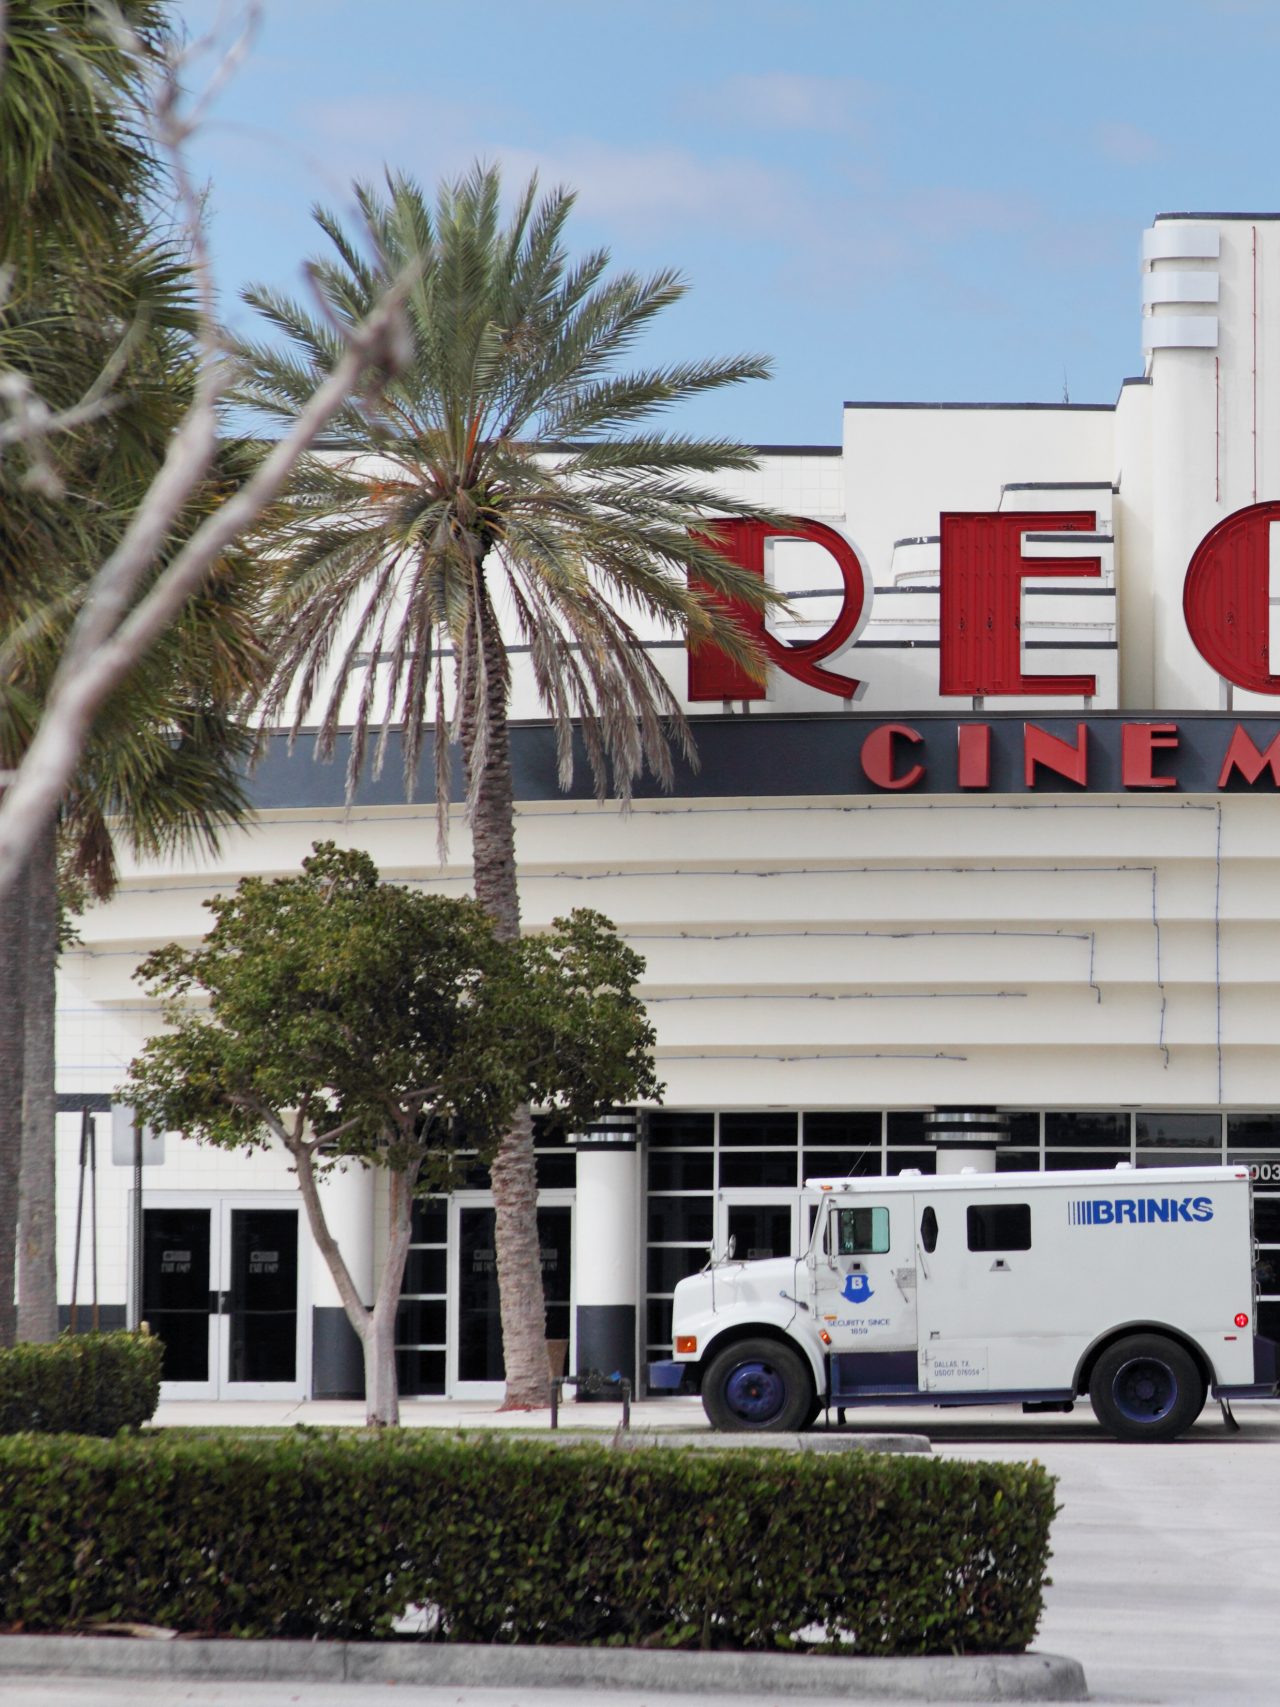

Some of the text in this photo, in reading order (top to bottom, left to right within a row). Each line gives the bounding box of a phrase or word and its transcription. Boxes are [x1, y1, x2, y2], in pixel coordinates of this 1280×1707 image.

[1091, 1197, 1214, 1225] BRINKS
[828, 1318, 890, 1327] SECURITY SINCE
